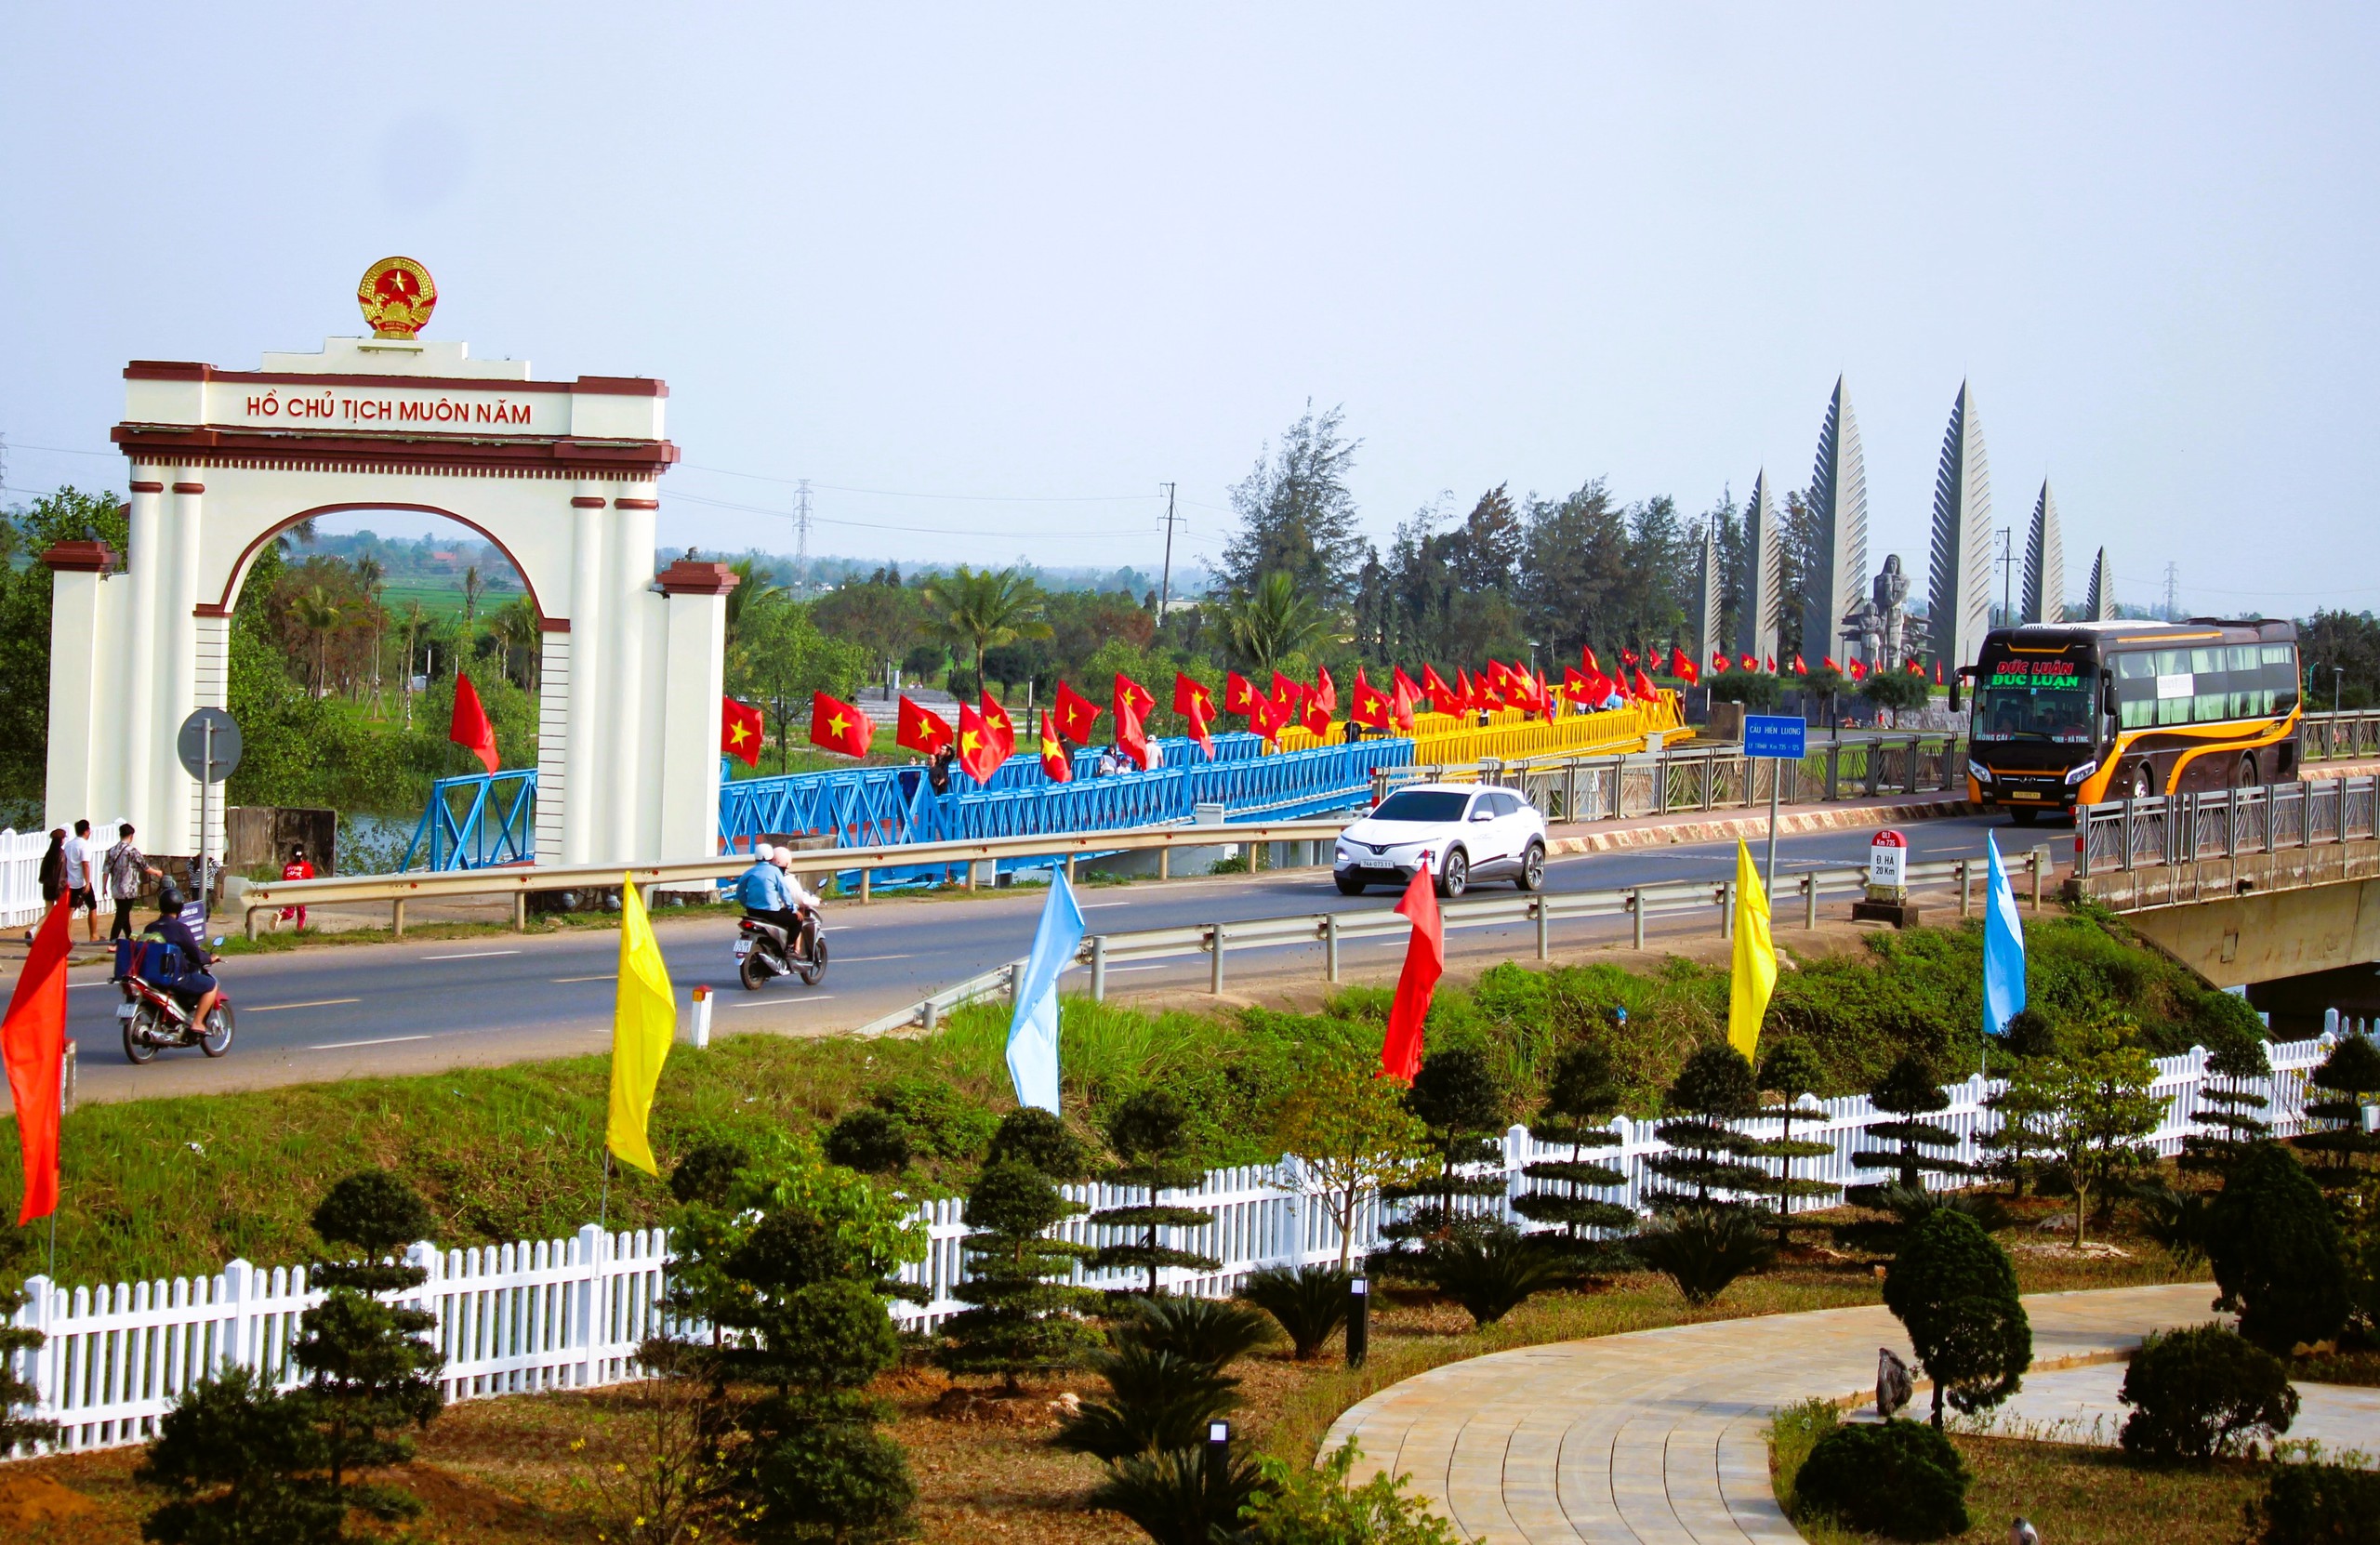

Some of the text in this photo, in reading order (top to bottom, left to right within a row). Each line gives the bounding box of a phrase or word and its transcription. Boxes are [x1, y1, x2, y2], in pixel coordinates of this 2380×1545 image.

[247, 389, 531, 425] HỒ CHỦ TỊCH MUÔN NĂM
[1997, 659, 2074, 677] ĐỨC LUẬN
[1875, 866, 1884, 875] 20
